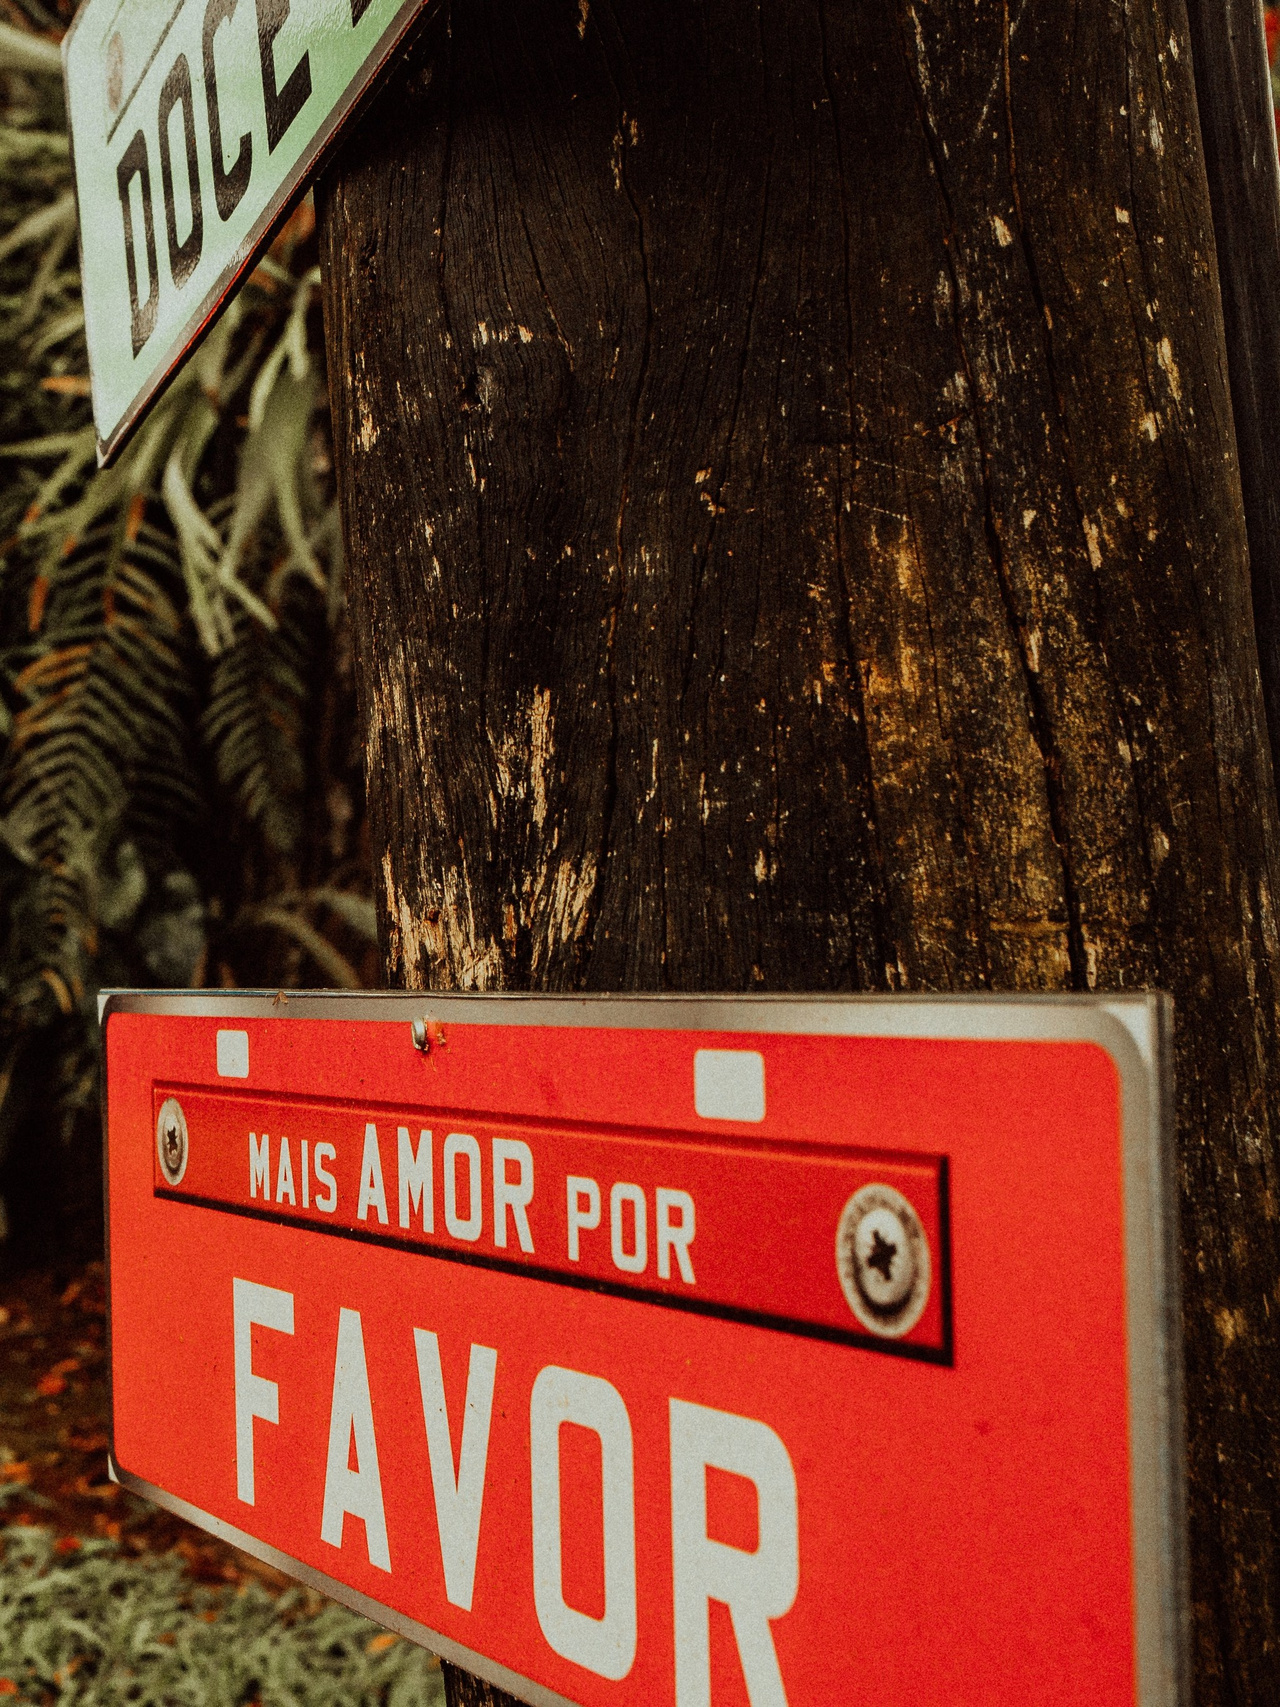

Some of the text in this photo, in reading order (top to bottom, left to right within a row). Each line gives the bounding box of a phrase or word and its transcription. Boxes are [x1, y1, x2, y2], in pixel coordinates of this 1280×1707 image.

[248, 1123, 696, 1284] MAIS AMOR POR
[232, 1276, 800, 1707] FAVOR
